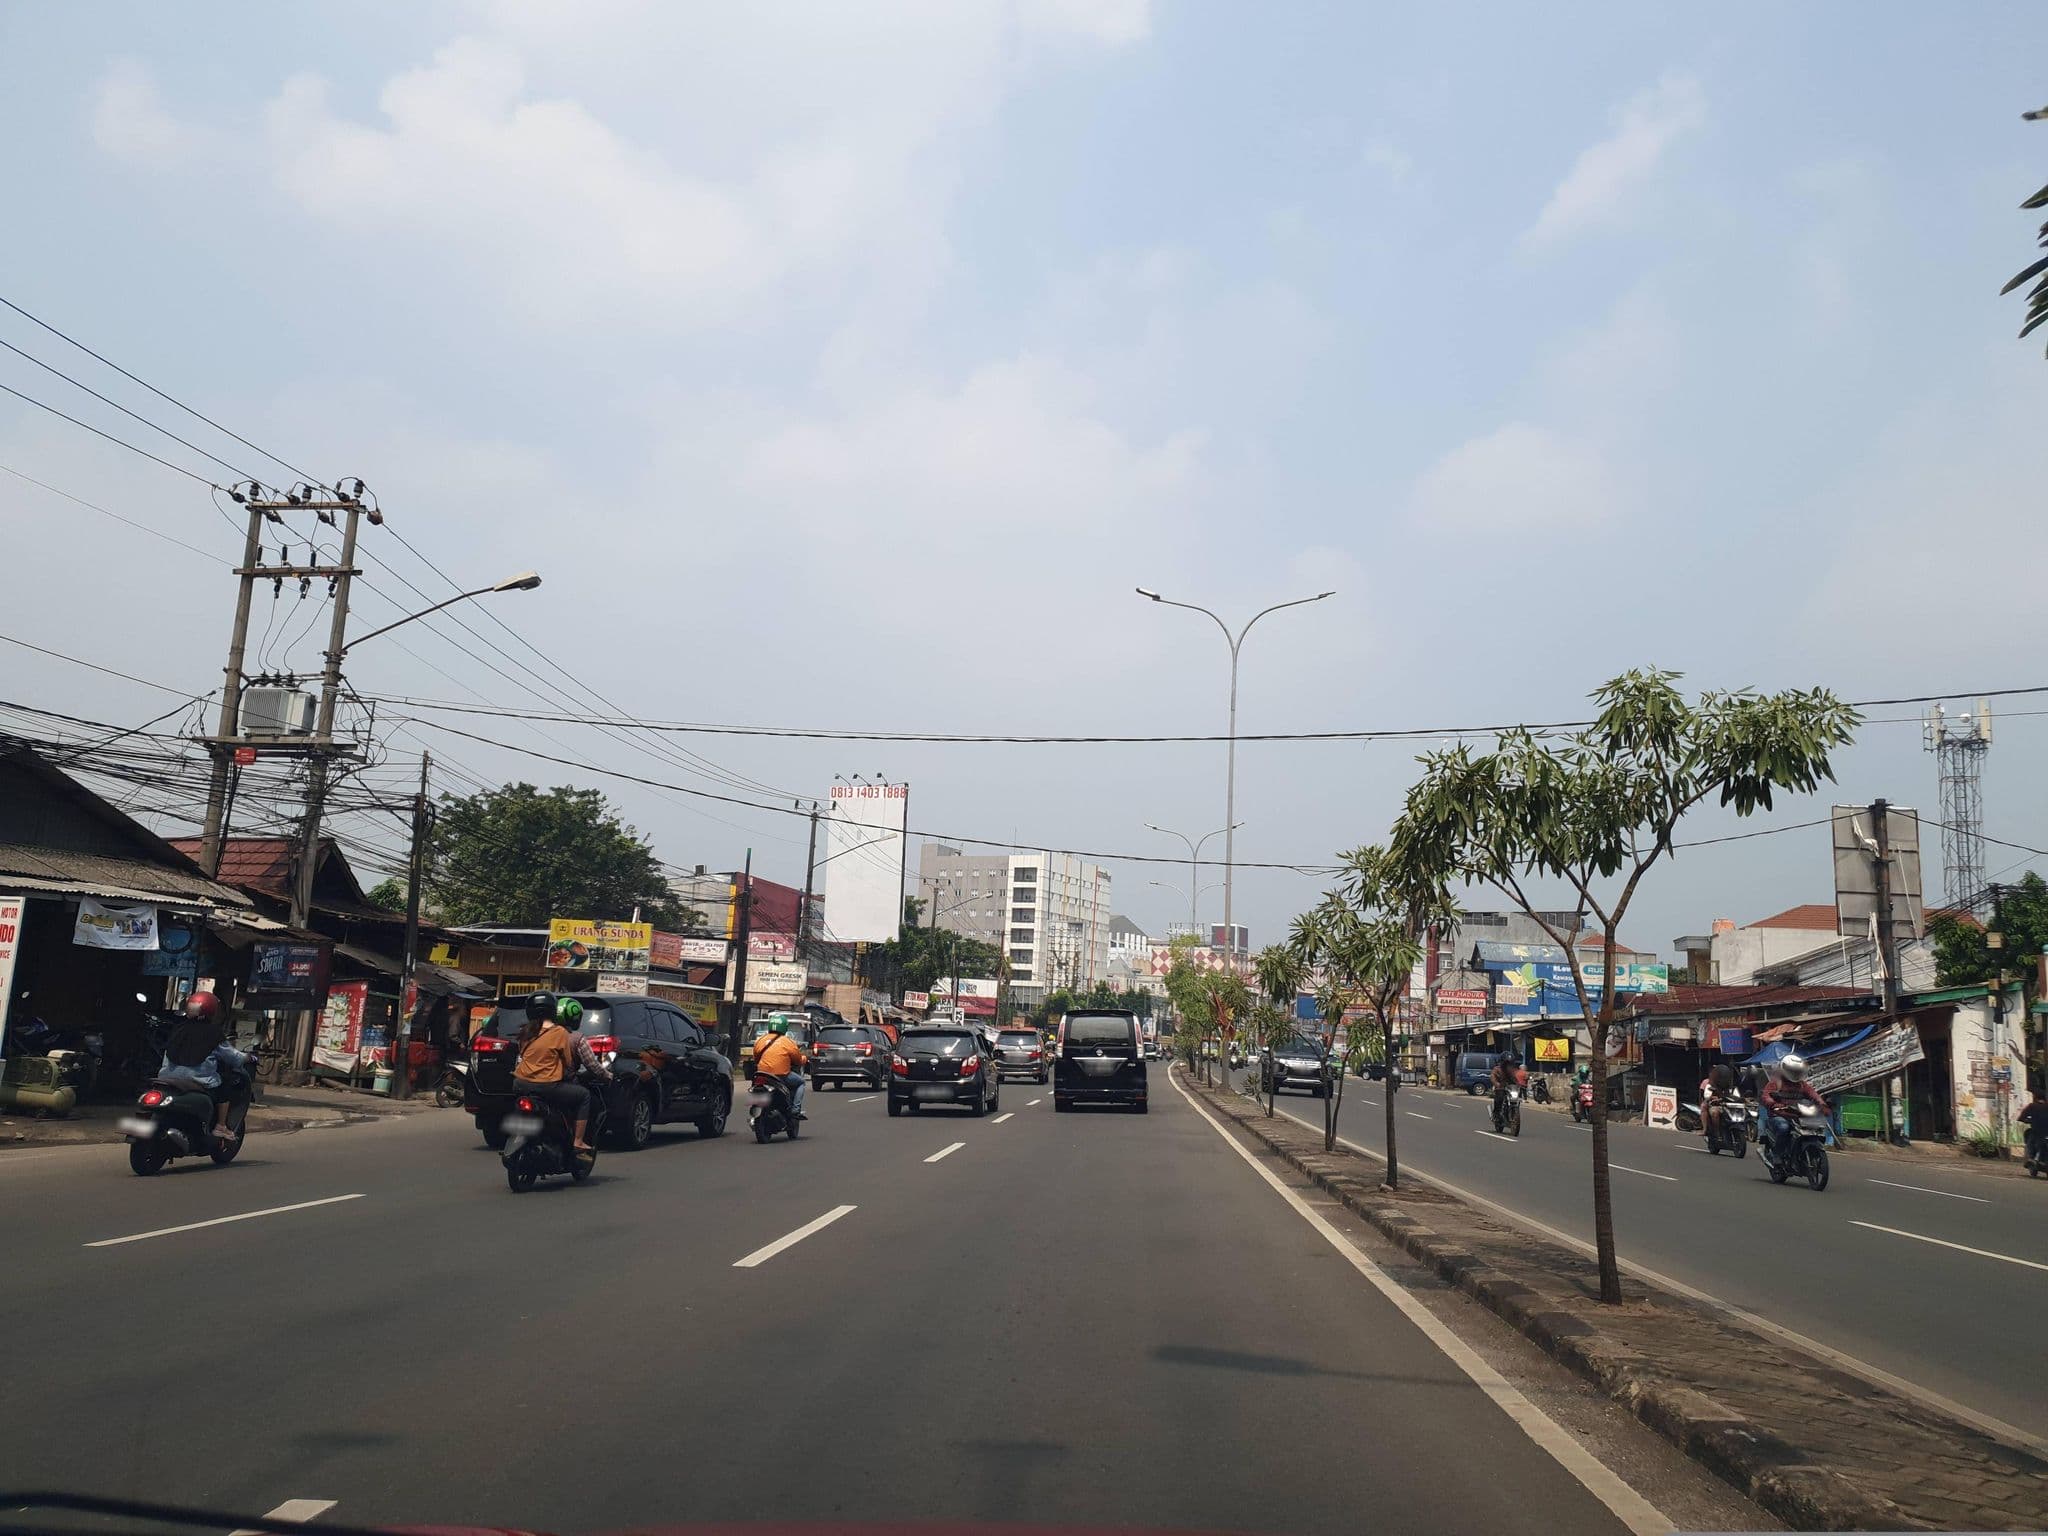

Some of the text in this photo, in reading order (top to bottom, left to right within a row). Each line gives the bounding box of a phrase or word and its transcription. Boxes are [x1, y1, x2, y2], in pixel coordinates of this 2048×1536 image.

[831, 787, 906, 799] 0813 1403 1888
[1, 907, 18, 919] MOTOR
[573, 926, 644, 939] URANG SUNDA
